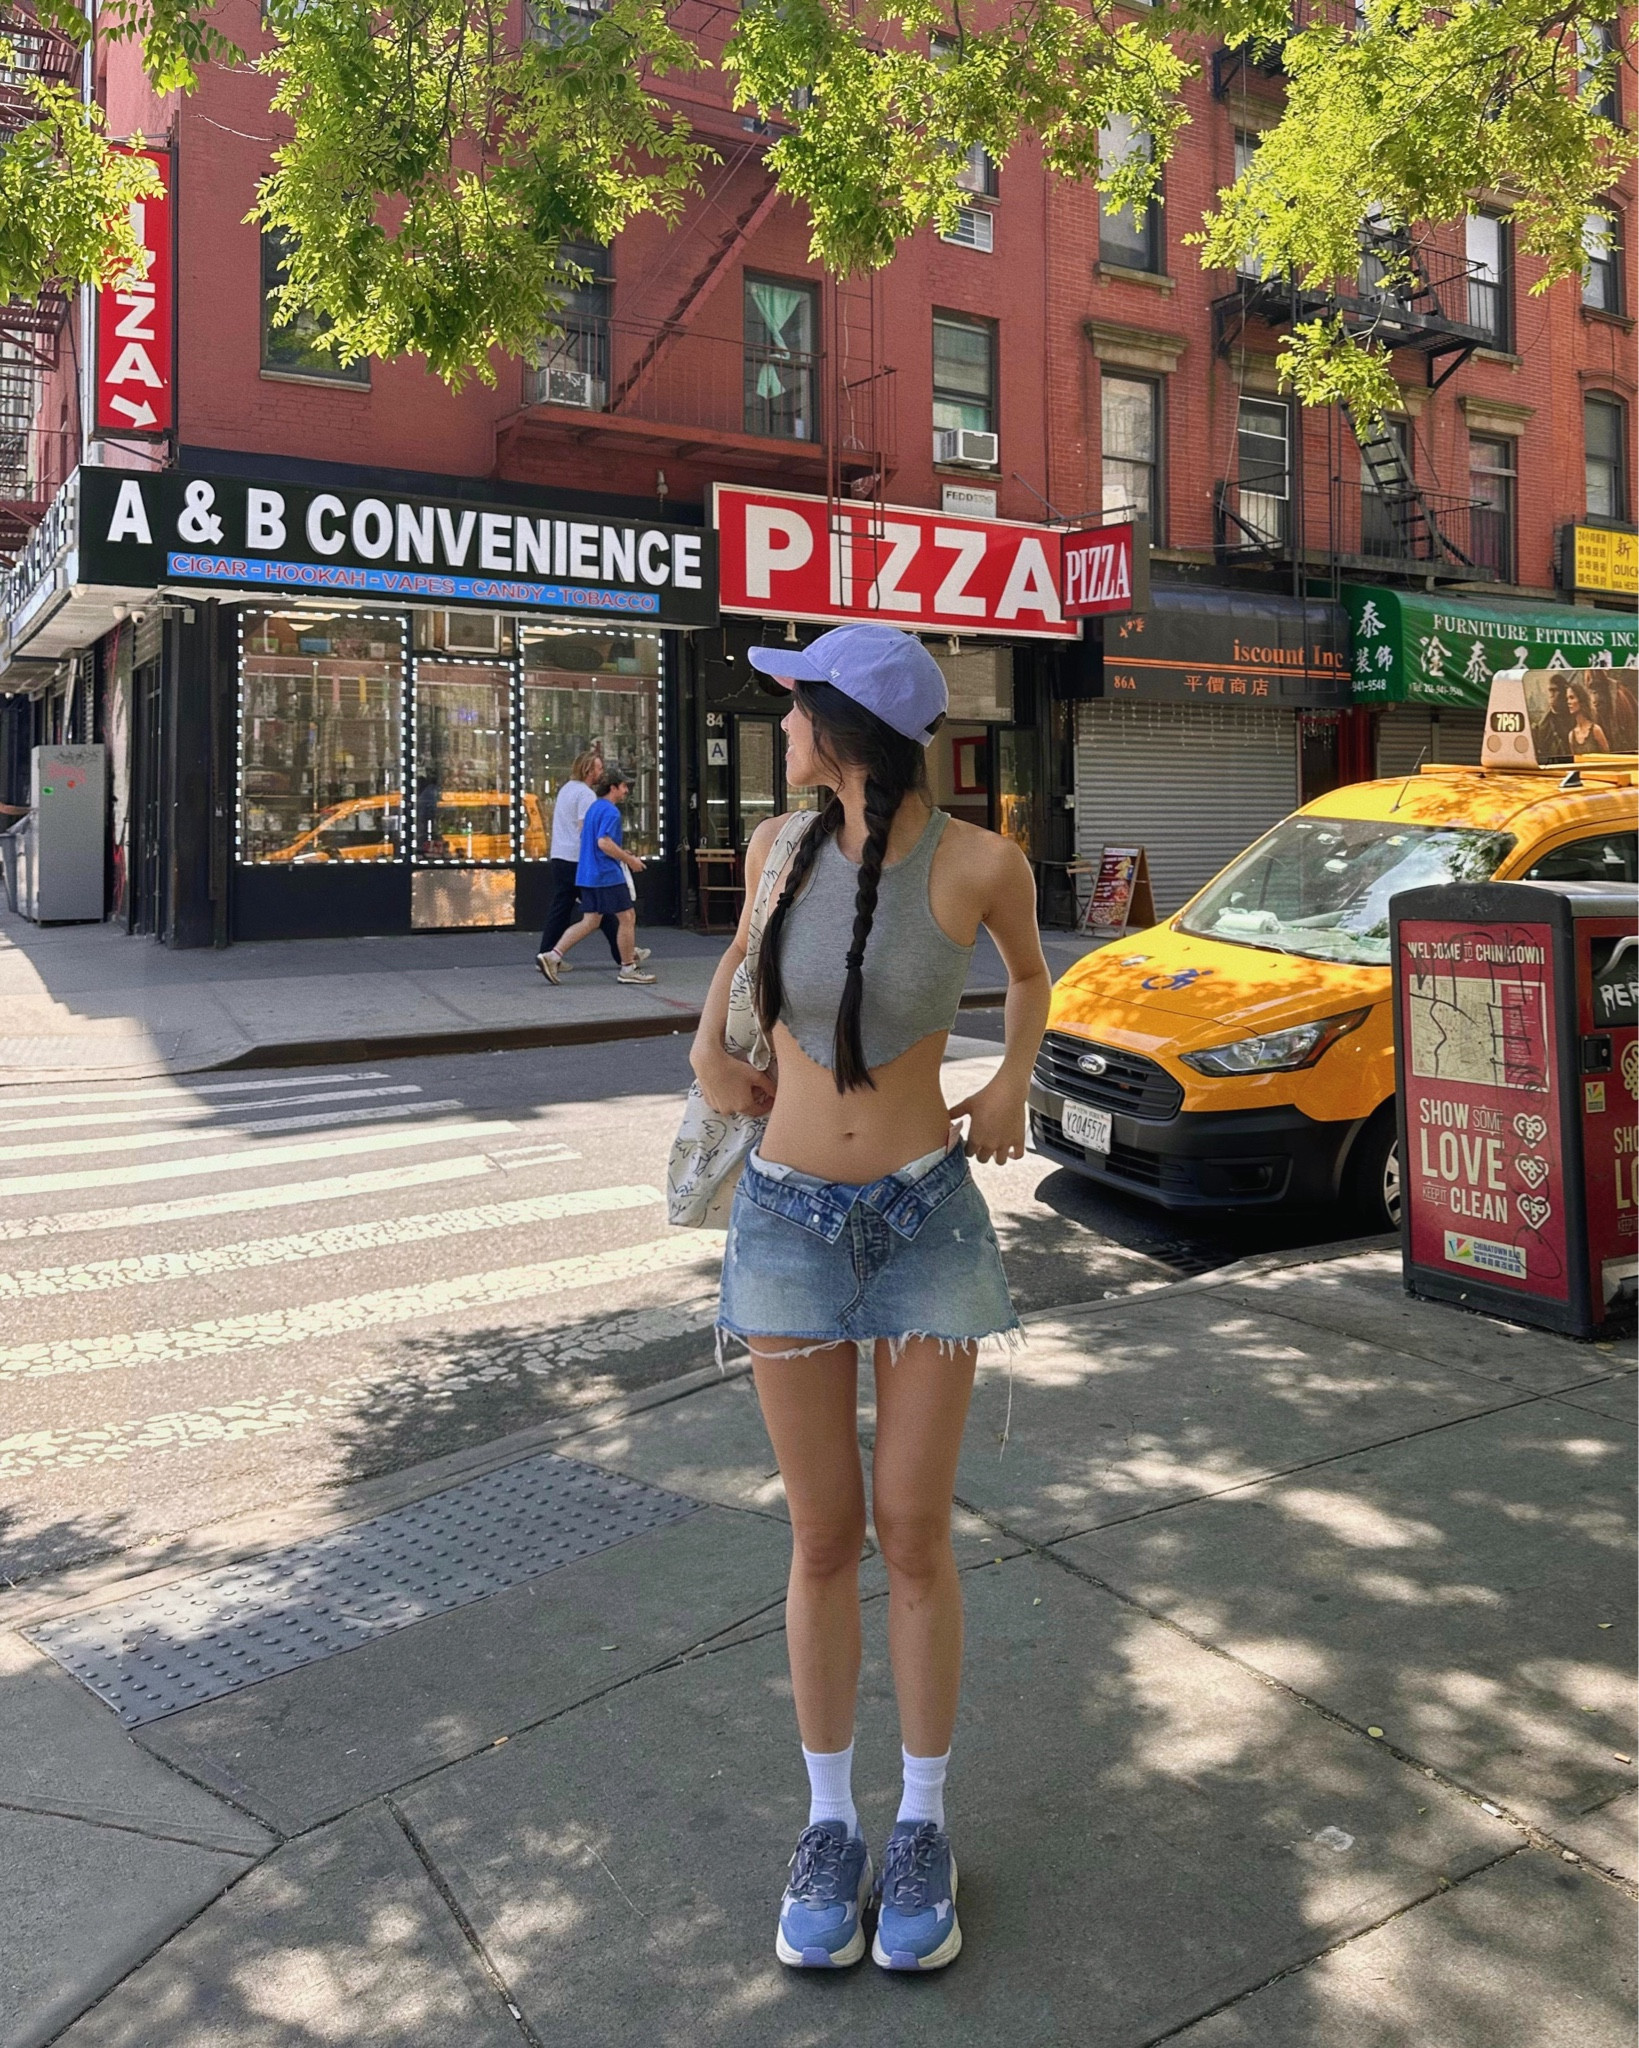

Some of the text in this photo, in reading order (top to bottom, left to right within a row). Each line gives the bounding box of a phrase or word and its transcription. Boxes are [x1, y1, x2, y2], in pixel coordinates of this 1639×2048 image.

[105, 160, 163, 388] IZZA
[106, 480, 702, 589] A & B CONVENIENCE
[745, 504, 1066, 624] PIZZA
[1065, 541, 1132, 605] PIZZA
[1614, 564, 1637, 578] QUIC
[172, 556, 248, 578] CIGAR
[266, 563, 366, 587] HOOKAH
[383, 574, 455, 594] VAPES
[472, 581, 545, 601] CANDY
[559, 588, 655, 610] TOBACCO
[1356, 600, 1386, 639] 泰
[1433, 614, 1637, 648] FURNITURE FITTINGS INC.
[1233, 639, 1344, 668] iscount Inc
[1113, 675, 1136, 690] 86A
[1183, 675, 1270, 697] 平價商店
[706, 712, 725, 728] 84
[1496, 713, 1520, 732] 7P51
[711, 742, 724, 758] A
[1475, 944, 1545, 964] CHINATOWN
[1420, 1098, 1504, 1132] SHOW SOME
[1420, 1128, 1507, 1191] LOVE
[1450, 1187, 1508, 1224] CLEAN
